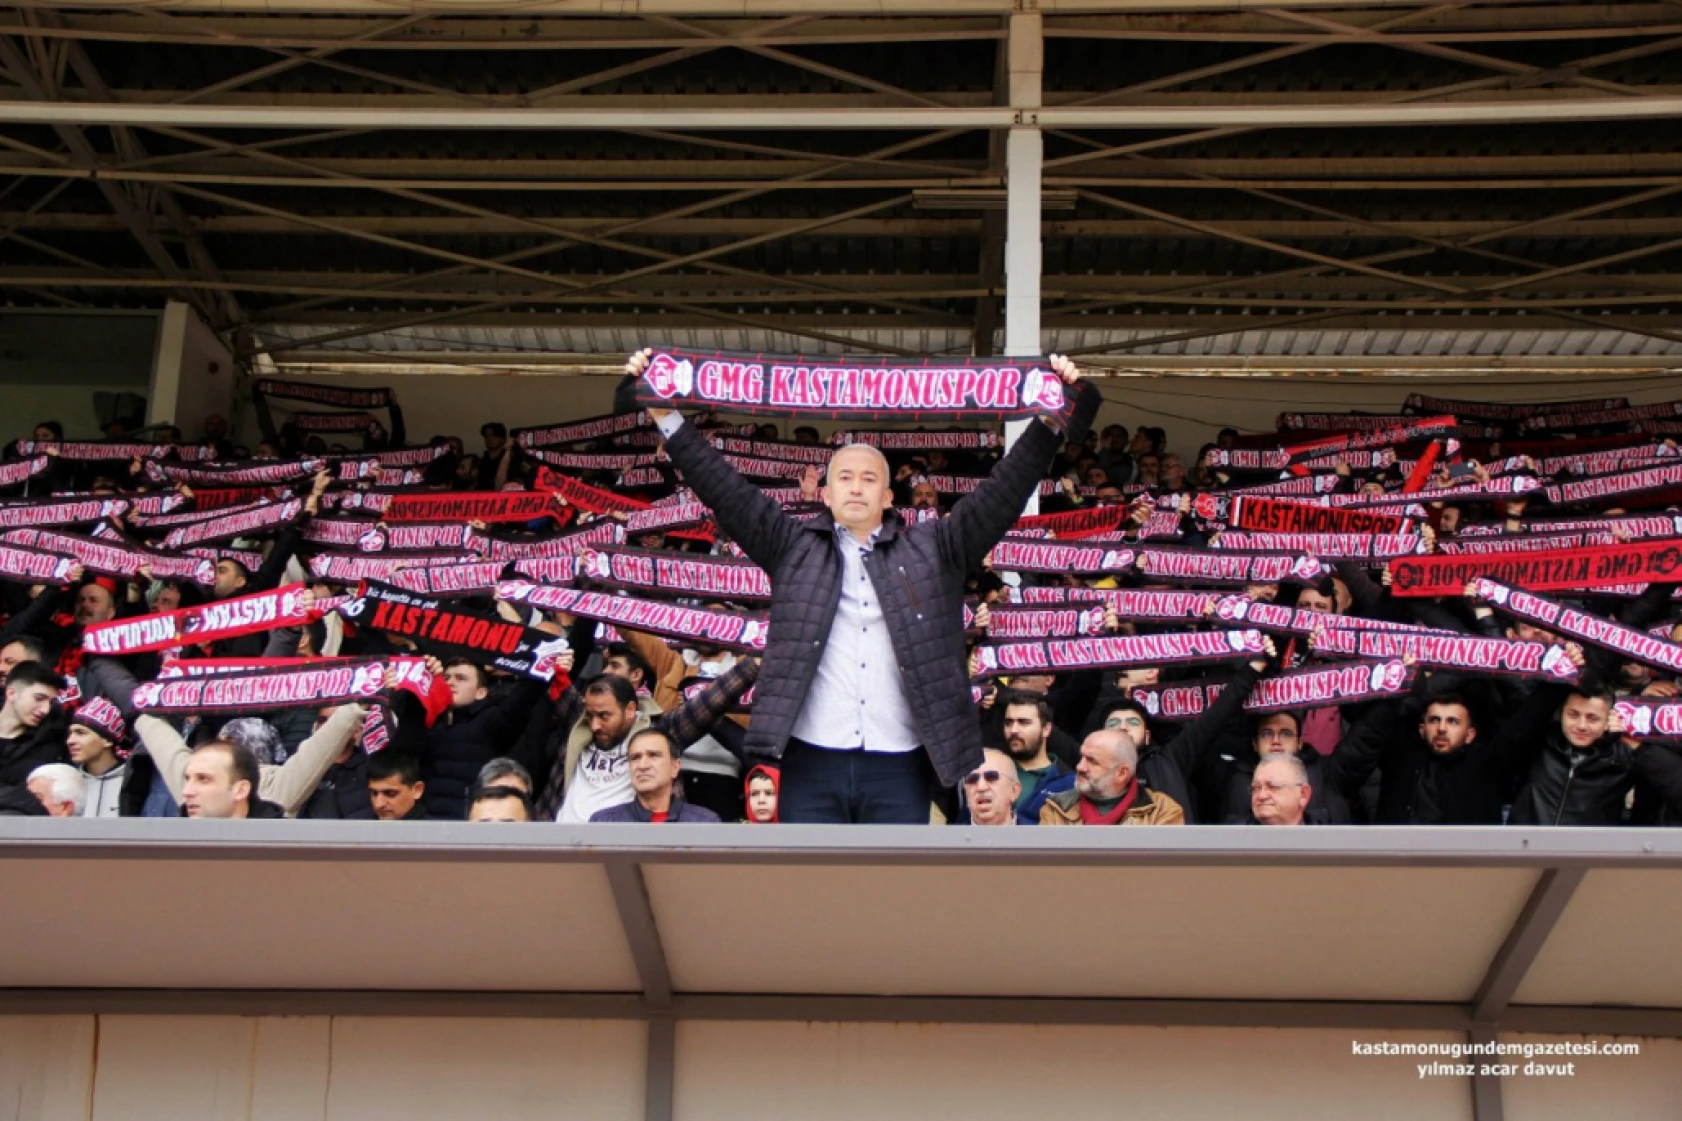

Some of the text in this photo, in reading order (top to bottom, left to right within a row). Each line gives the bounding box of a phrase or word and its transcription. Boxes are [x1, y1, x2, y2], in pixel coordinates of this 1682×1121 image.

[699, 361, 1021, 409] GMG KASTAMONUSPOR
[612, 553, 772, 596] GMG KASTAMONU
[991, 541, 1103, 570] TAMONUSPOR
[529, 586, 576, 609] GMG
[571, 591, 745, 641] KASTAMONUSPOR
[1249, 602, 1292, 627] GMG
[1509, 591, 1560, 622] GMG
[371, 600, 525, 655] KASTAMONU
[999, 630, 1231, 669] GMG KASTAMONUSPOR
[1358, 631, 1545, 671] KASTAMONUSPOR
[161, 680, 203, 706] GMG
[203, 668, 352, 705] KASTAMONUSPOR
[1161, 687, 1204, 716] GMG
